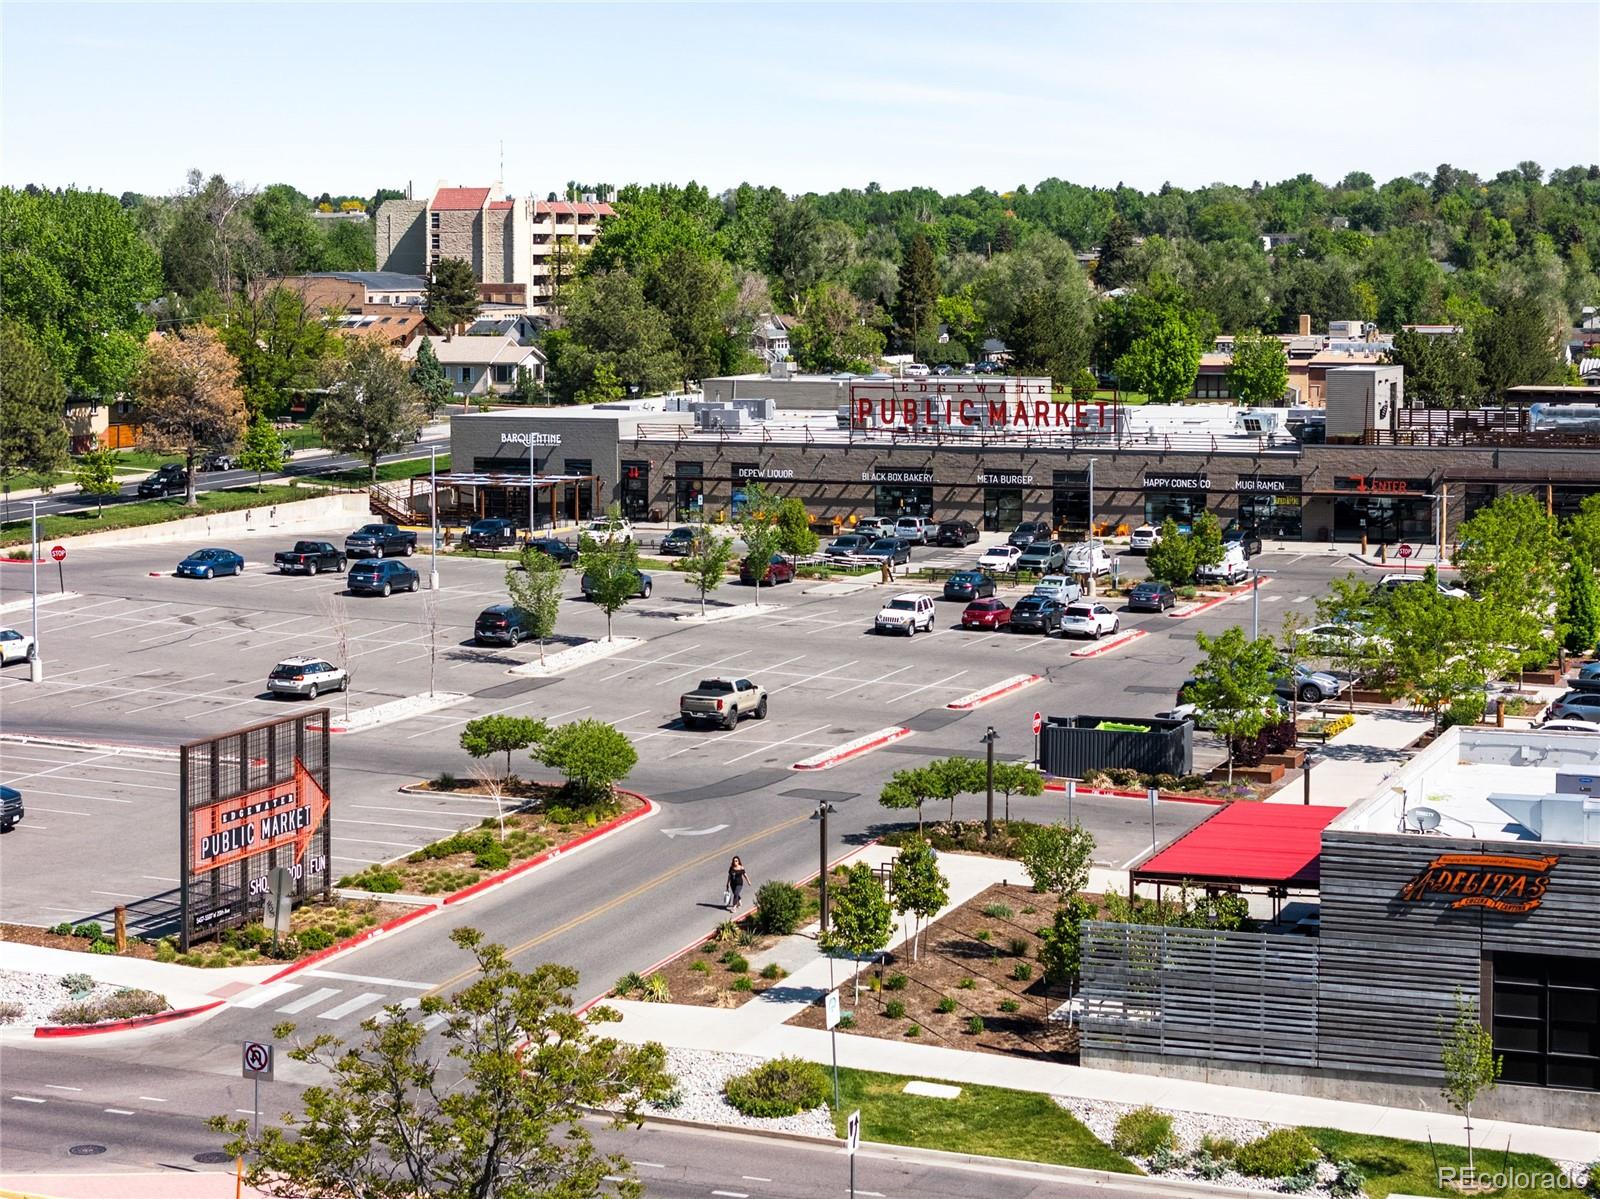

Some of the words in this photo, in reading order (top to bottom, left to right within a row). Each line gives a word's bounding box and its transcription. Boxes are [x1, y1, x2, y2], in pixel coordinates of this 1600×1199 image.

[901, 383, 1064, 395] EDGEWATER
[857, 397, 974, 426] PUBLIC
[988, 399, 1108, 427] MARKET
[501, 432, 562, 447] BARQUENTINE
[738, 468, 765, 478] DEPEW
[767, 469, 794, 479] LIQUOR
[862, 472, 886, 481] BLACK
[887, 472, 902, 482] BOX
[903, 473, 934, 482] BAKERY
[977, 474, 999, 484] META
[1000, 475, 1034, 485] BURGER
[1143, 478, 1170, 488] HAPPY
[1171, 479, 1198, 488] CONES
[1200, 479, 1211, 489] CO
[1235, 480, 1255, 490] MUGI
[1256, 481, 1285, 491] RAMEN
[1372, 480, 1407, 493] ENTER
[222, 793, 294, 824] EDGEWATER
[201, 822, 255, 860] PUBLIC
[261, 804, 311, 841] MARKET
[250, 876, 270, 896] SHO
[310, 854, 326, 874] FUN
[1402, 869, 1551, 900] ADELITAS
